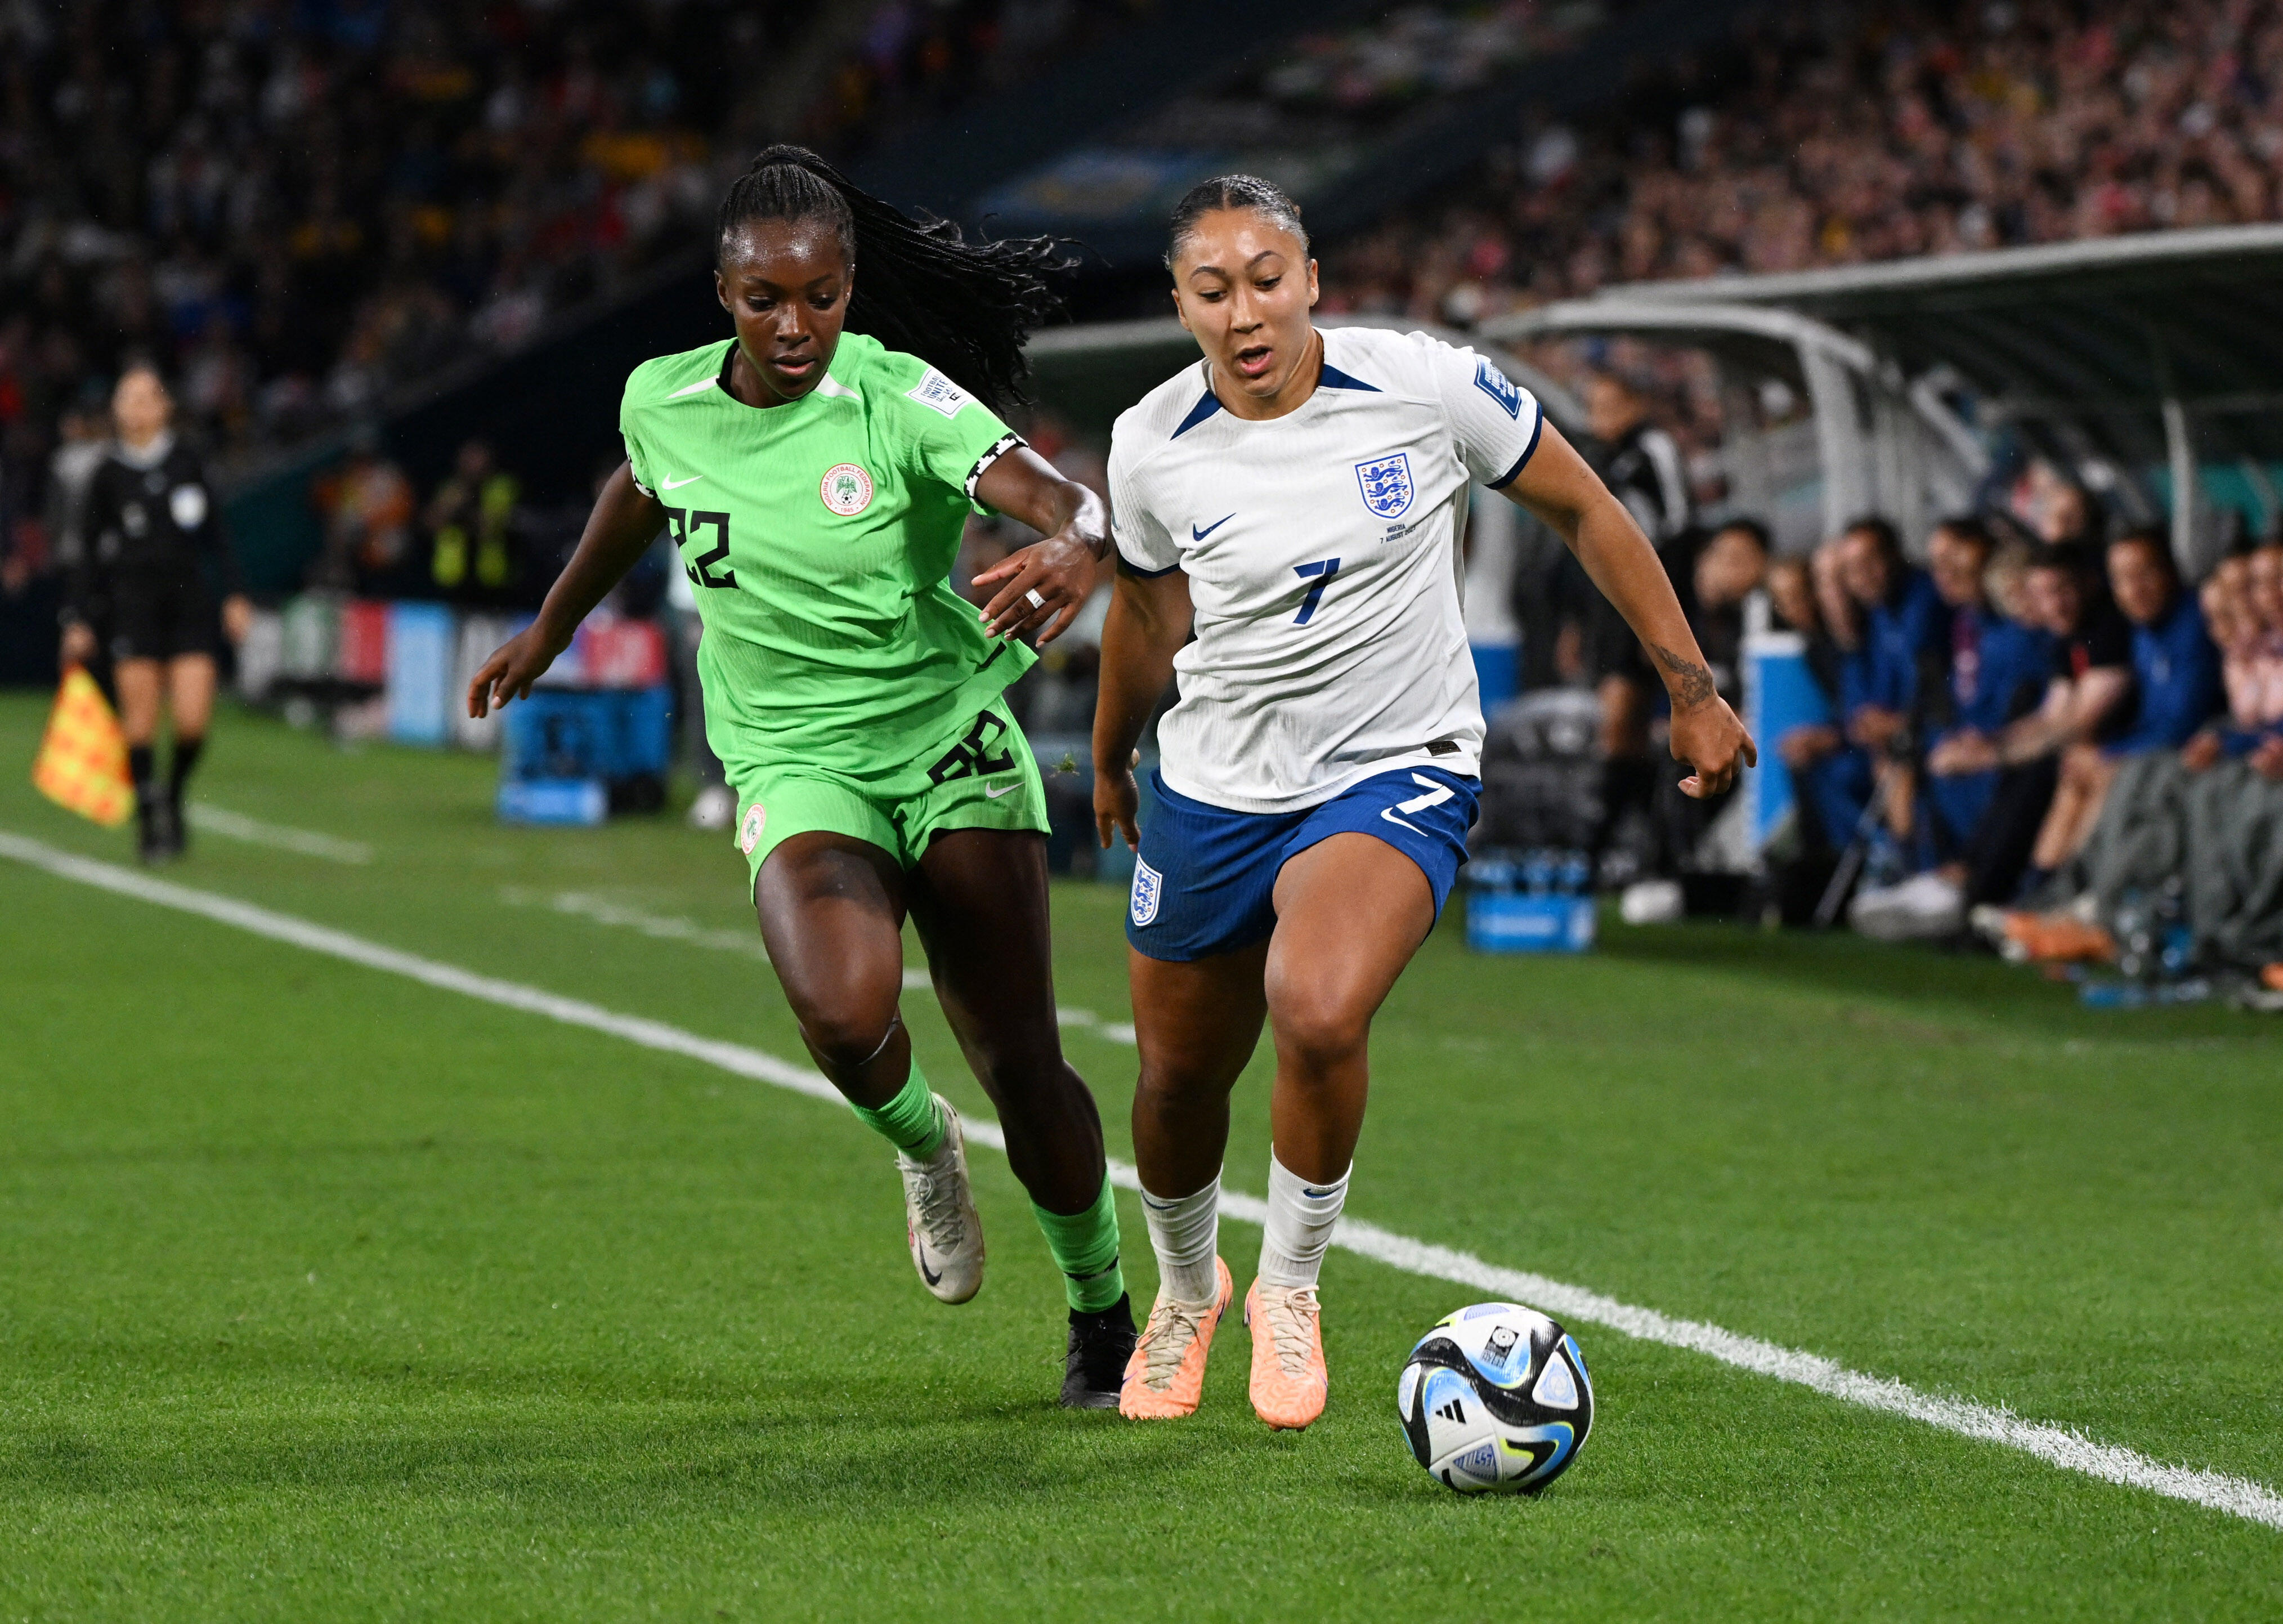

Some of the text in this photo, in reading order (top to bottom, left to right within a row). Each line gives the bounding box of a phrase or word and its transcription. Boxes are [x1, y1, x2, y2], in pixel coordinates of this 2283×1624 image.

[927, 378, 949, 399] UNITE
[823, 466, 870, 506] NIGERIA FOOTBALL FEDERATION
[663, 505, 740, 589] 22
[1386, 524, 1406, 533] NIGERIA
[1293, 557, 1341, 625] 7
[926, 710, 1016, 785] 22
[1396, 772, 1456, 815] 7
